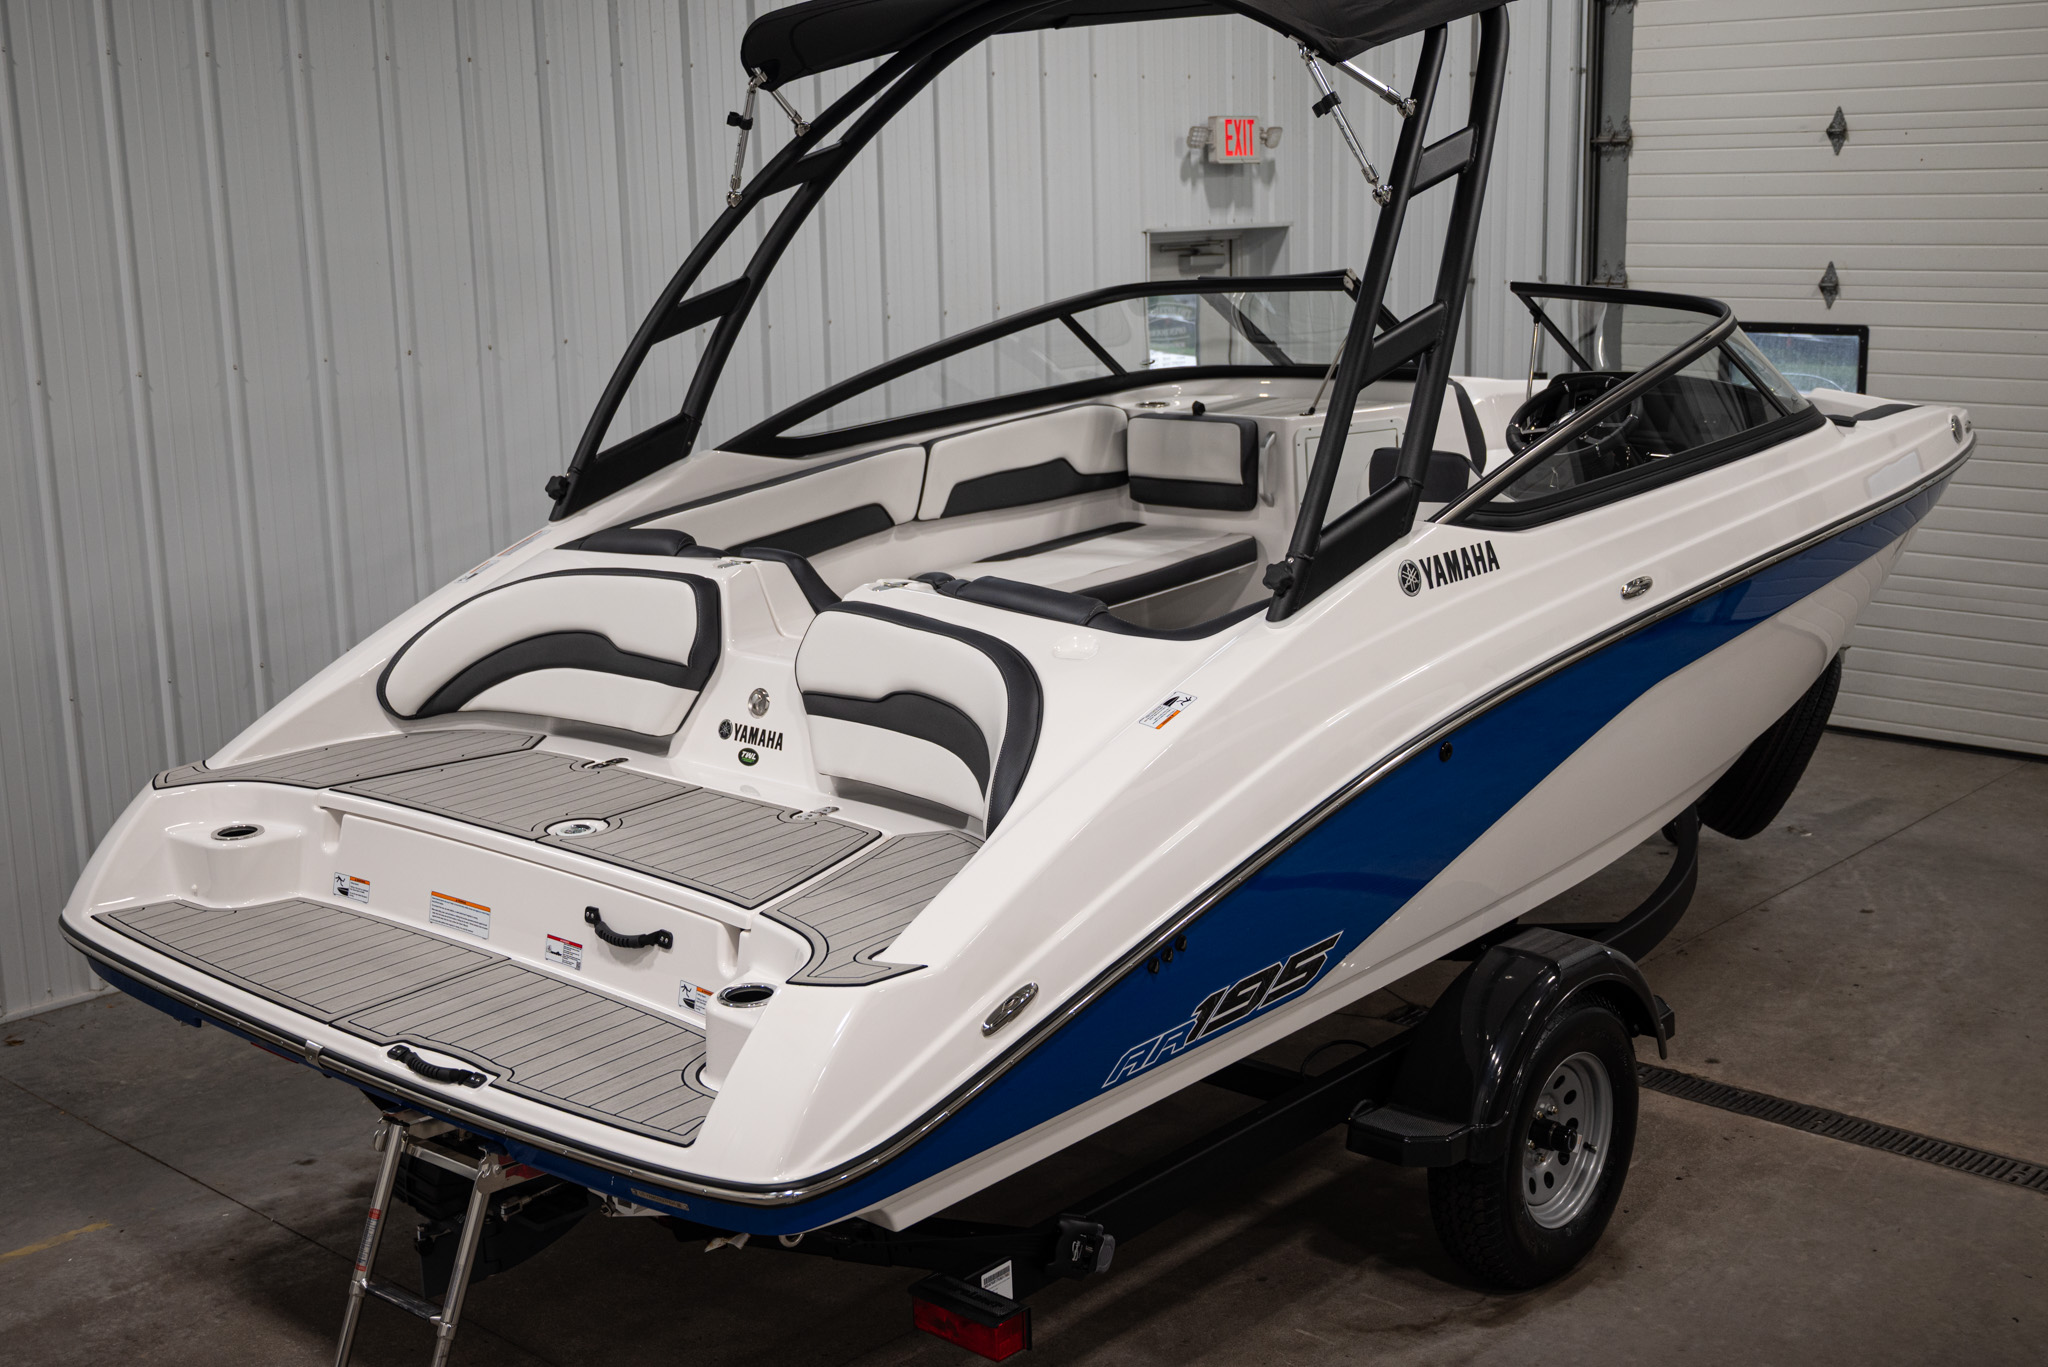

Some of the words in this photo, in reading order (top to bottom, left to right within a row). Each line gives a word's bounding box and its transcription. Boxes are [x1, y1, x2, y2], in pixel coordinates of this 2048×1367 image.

[1224, 119, 1254, 156] EXIT
[1419, 540, 1500, 590] YAMAHA
[734, 723, 783, 751] YAMAHA
